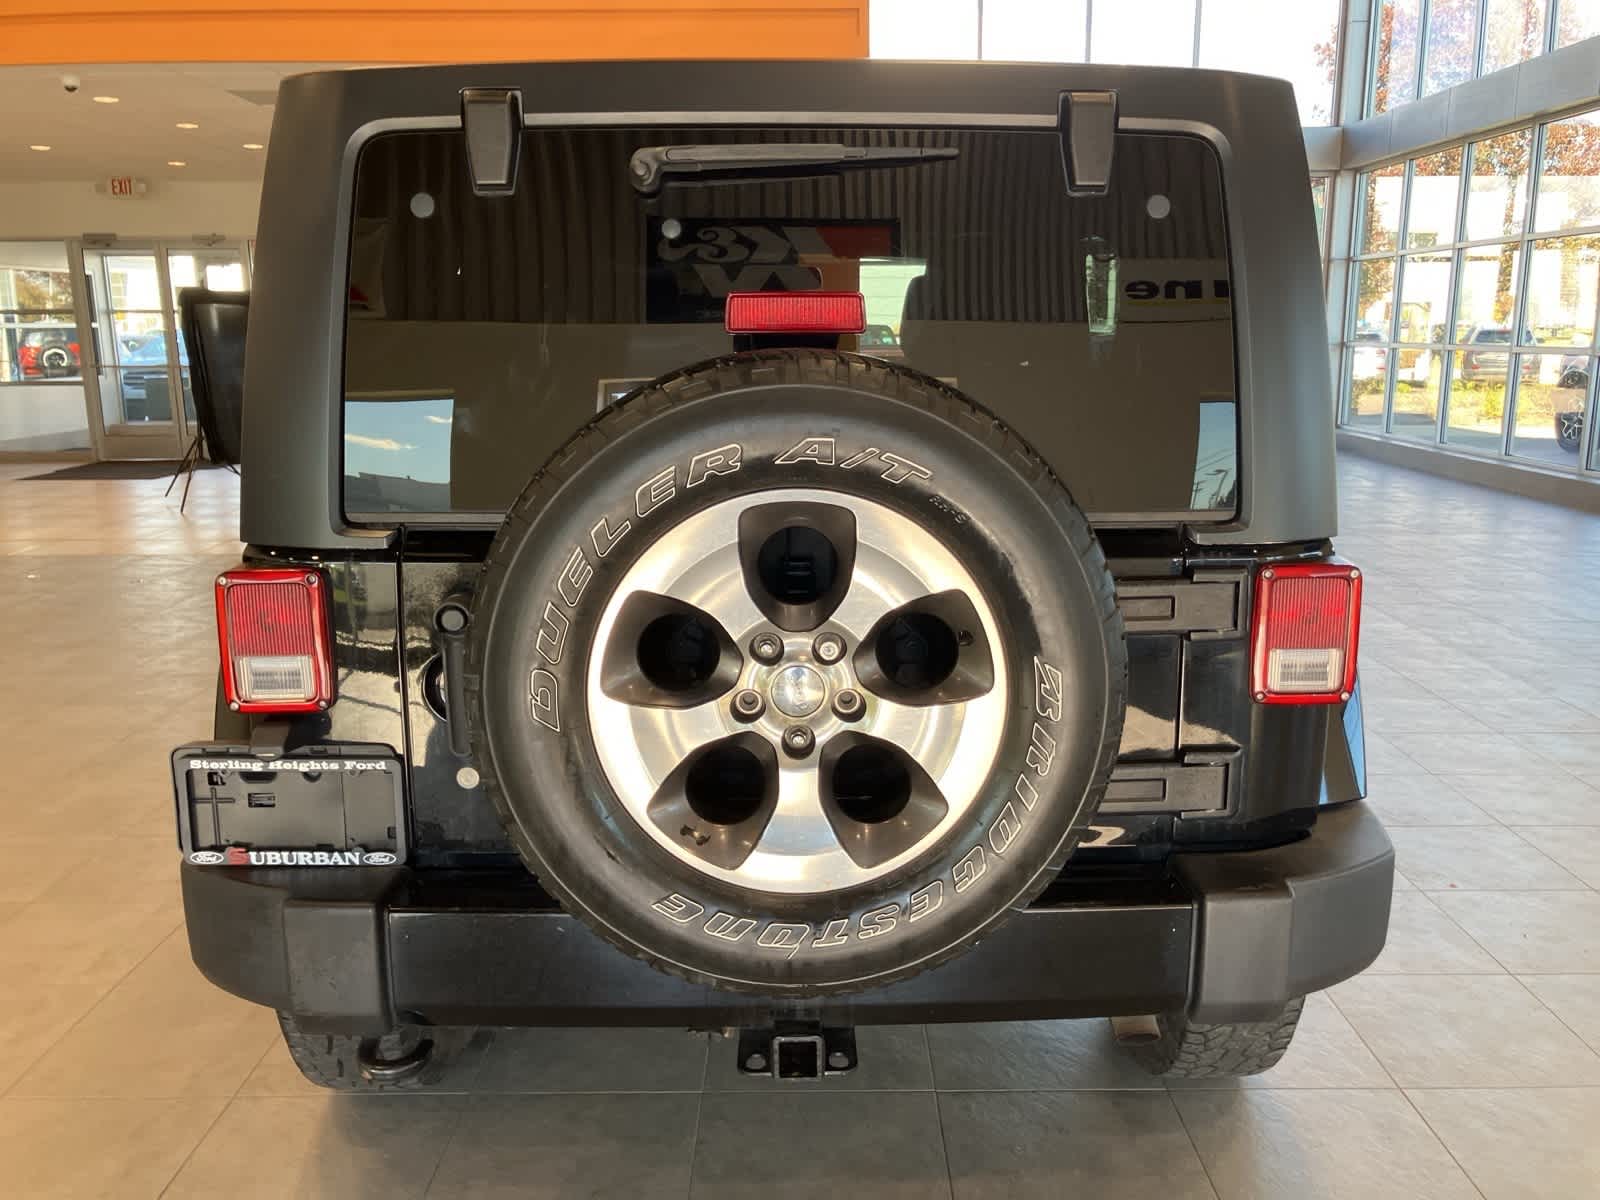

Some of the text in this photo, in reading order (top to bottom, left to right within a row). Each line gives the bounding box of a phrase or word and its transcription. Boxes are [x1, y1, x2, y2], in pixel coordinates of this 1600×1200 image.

[111, 177, 132, 196] EXIT
[529, 443, 742, 733] DUELER
[775, 437, 933, 485] A/T
[190, 760, 387, 771] Sterling Heights Ford
[651, 655, 1065, 960] BRIDGESTONE
[192, 848, 395, 865] Ford SUBURBAN Ford
